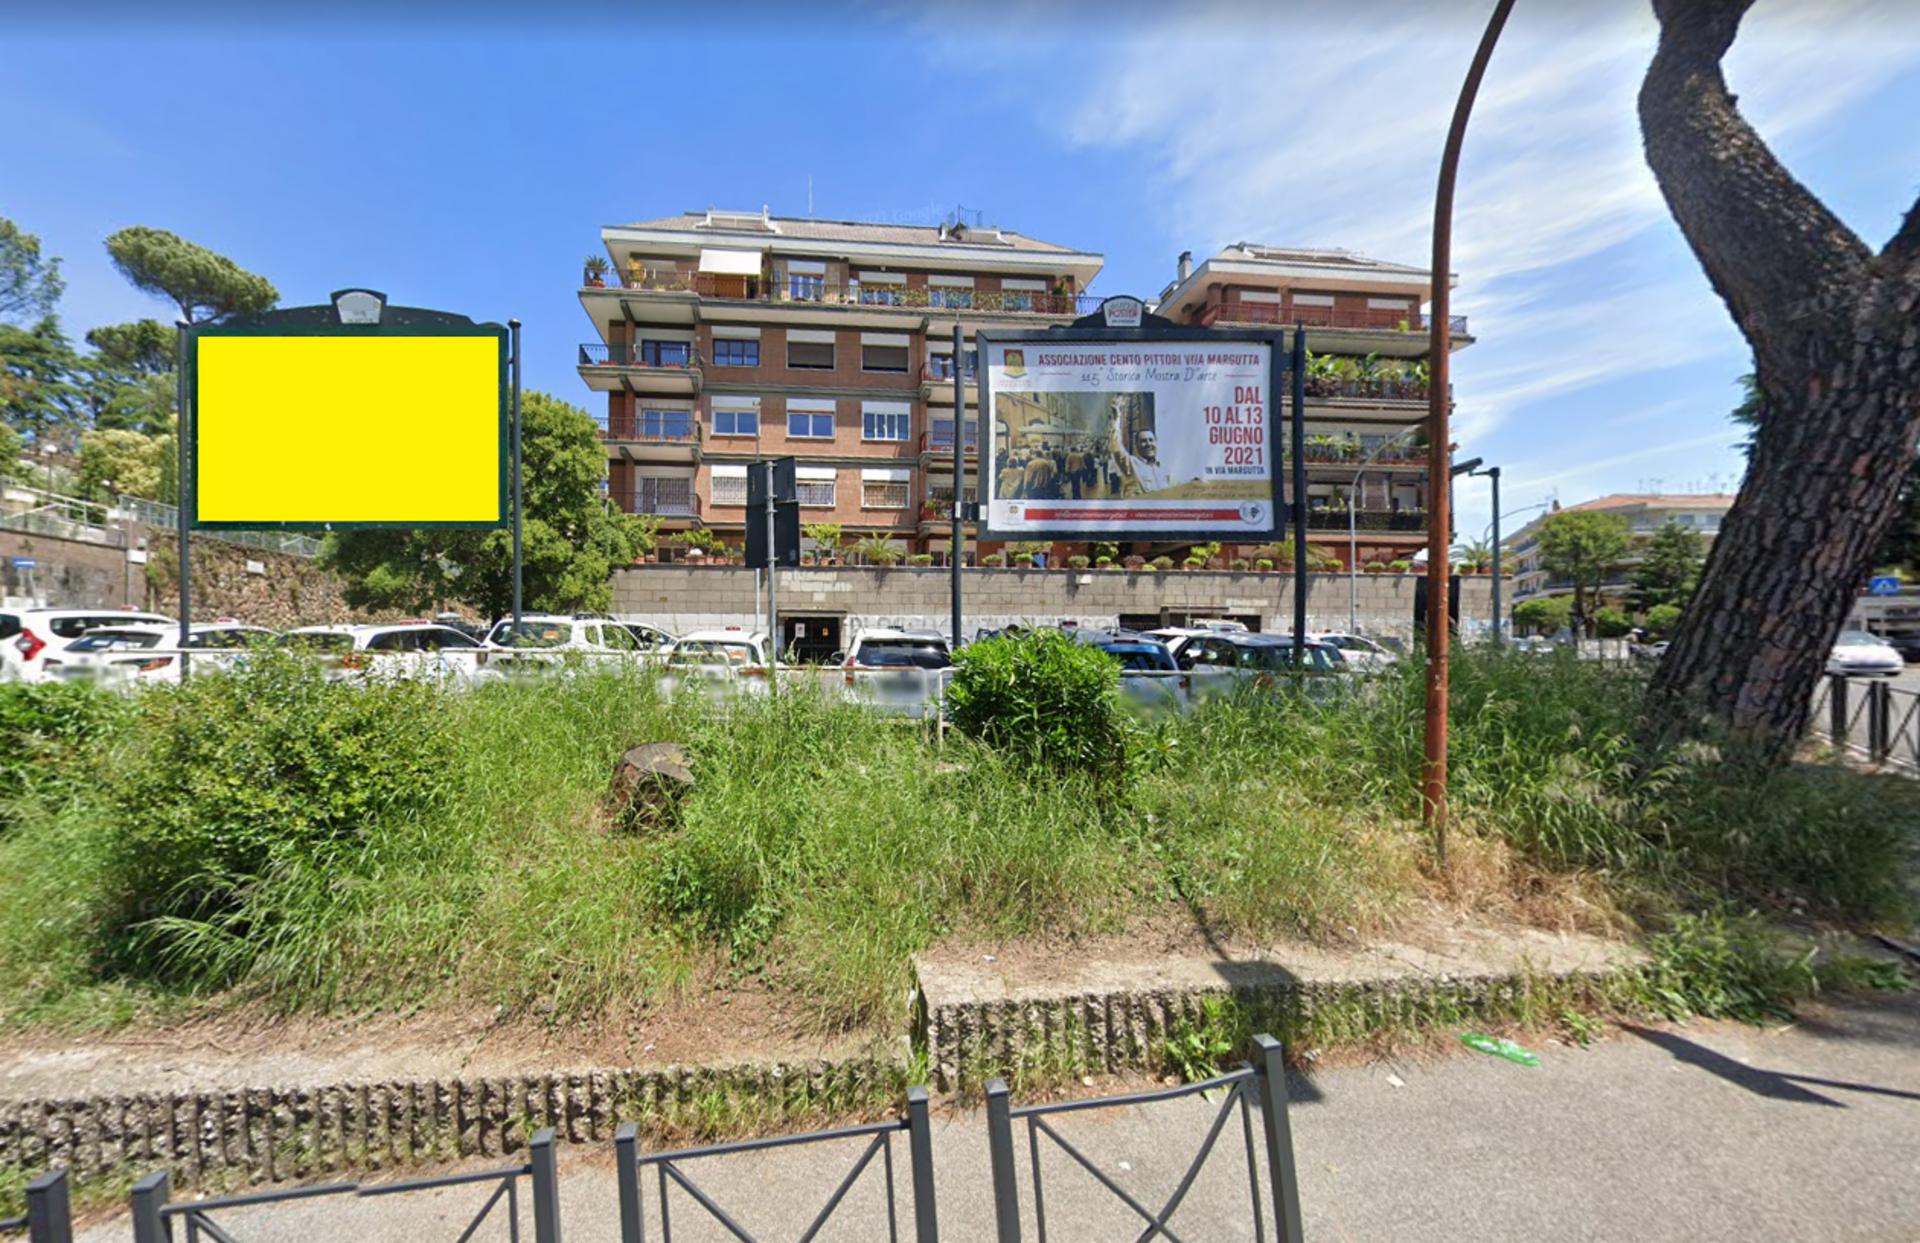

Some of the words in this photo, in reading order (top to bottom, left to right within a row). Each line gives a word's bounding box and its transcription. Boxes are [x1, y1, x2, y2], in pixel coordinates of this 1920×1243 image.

[1038, 353, 1107, 366] ASSOCIAZIONE
[1110, 353, 1141, 366] CENTO
[1143, 353, 1182, 366] PITTORI
[1207, 353, 1260, 366] MARGUTTA
[1145, 367, 1180, 381] Mostra
[1234, 386, 1263, 404] DAL
[1203, 406, 1221, 424] 10
[1225, 406, 1243, 424] AL
[1244, 406, 1263, 424] 13
[1209, 426, 1264, 445] GIUGNO
[1224, 447, 1263, 465] 2021
[1215, 466, 1226, 474] VIA
[1227, 466, 1265, 475] MARGUTTA
